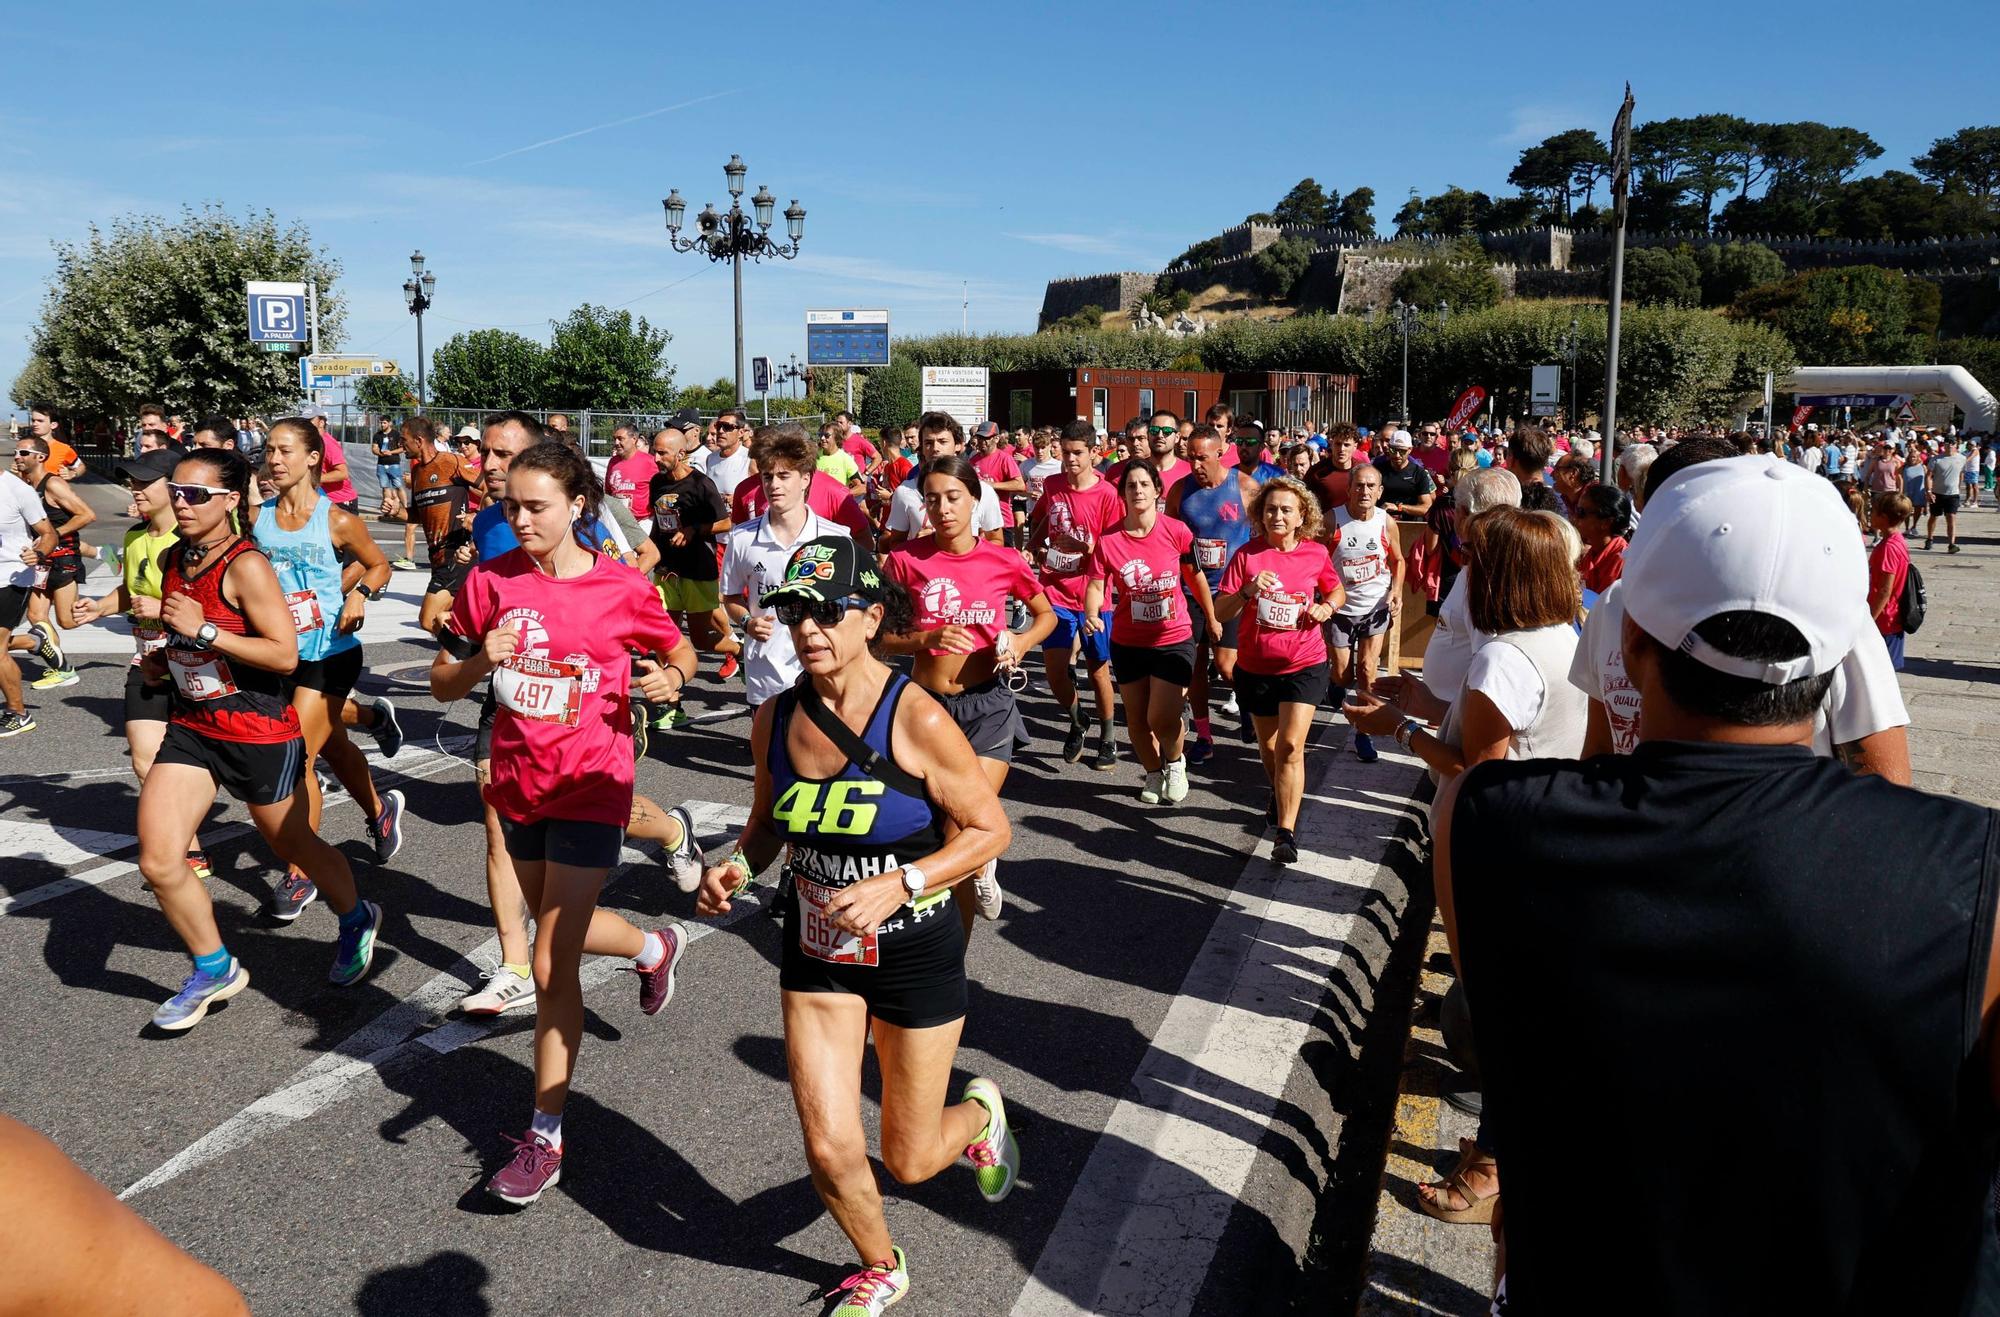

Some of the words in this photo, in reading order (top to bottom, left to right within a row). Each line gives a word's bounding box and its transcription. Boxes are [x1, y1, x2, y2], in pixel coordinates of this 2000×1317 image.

[266, 300, 290, 328] P
[265, 343, 291, 352] LIBRE
[313, 363, 348, 371] parador
[1142, 375, 1153, 384] de
[1157, 375, 1195, 386] turismo
[1829, 394, 1876, 406] SAÍDA
[1355, 566, 1370, 579] 571
[958, 609, 996, 618] ANDAR
[1142, 604, 1163, 619] 480
[1268, 606, 1292, 623] 585
[952, 617, 994, 625] CORRER
[517, 657, 550, 669] ANDAR
[524, 664, 561, 678] CORRER
[513, 681, 554, 710] 497
[773, 780, 885, 836] 46
[798, 846, 899, 881] YAMAHA
